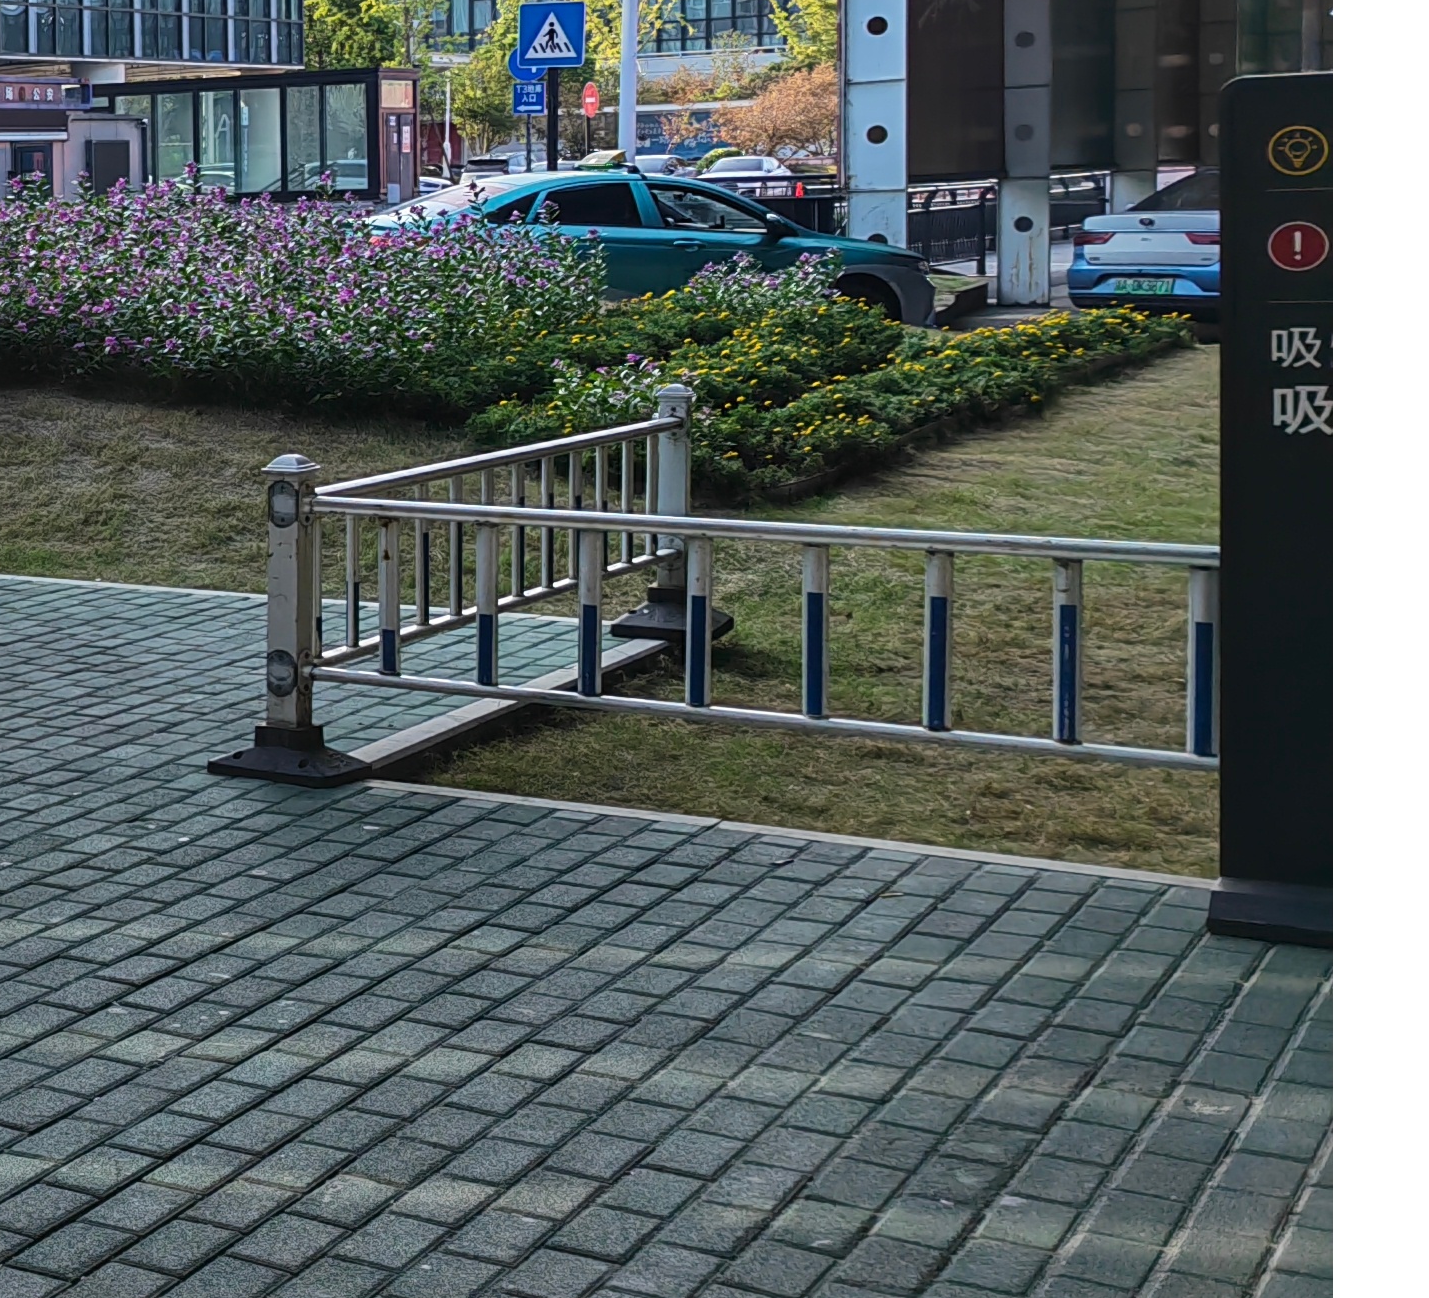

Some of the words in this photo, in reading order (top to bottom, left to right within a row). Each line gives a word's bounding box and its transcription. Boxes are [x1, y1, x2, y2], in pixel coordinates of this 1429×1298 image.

[521, 93, 537, 103] 入口
[1271, 327, 1333, 369] 吸
[1272, 385, 1333, 436] 吸
